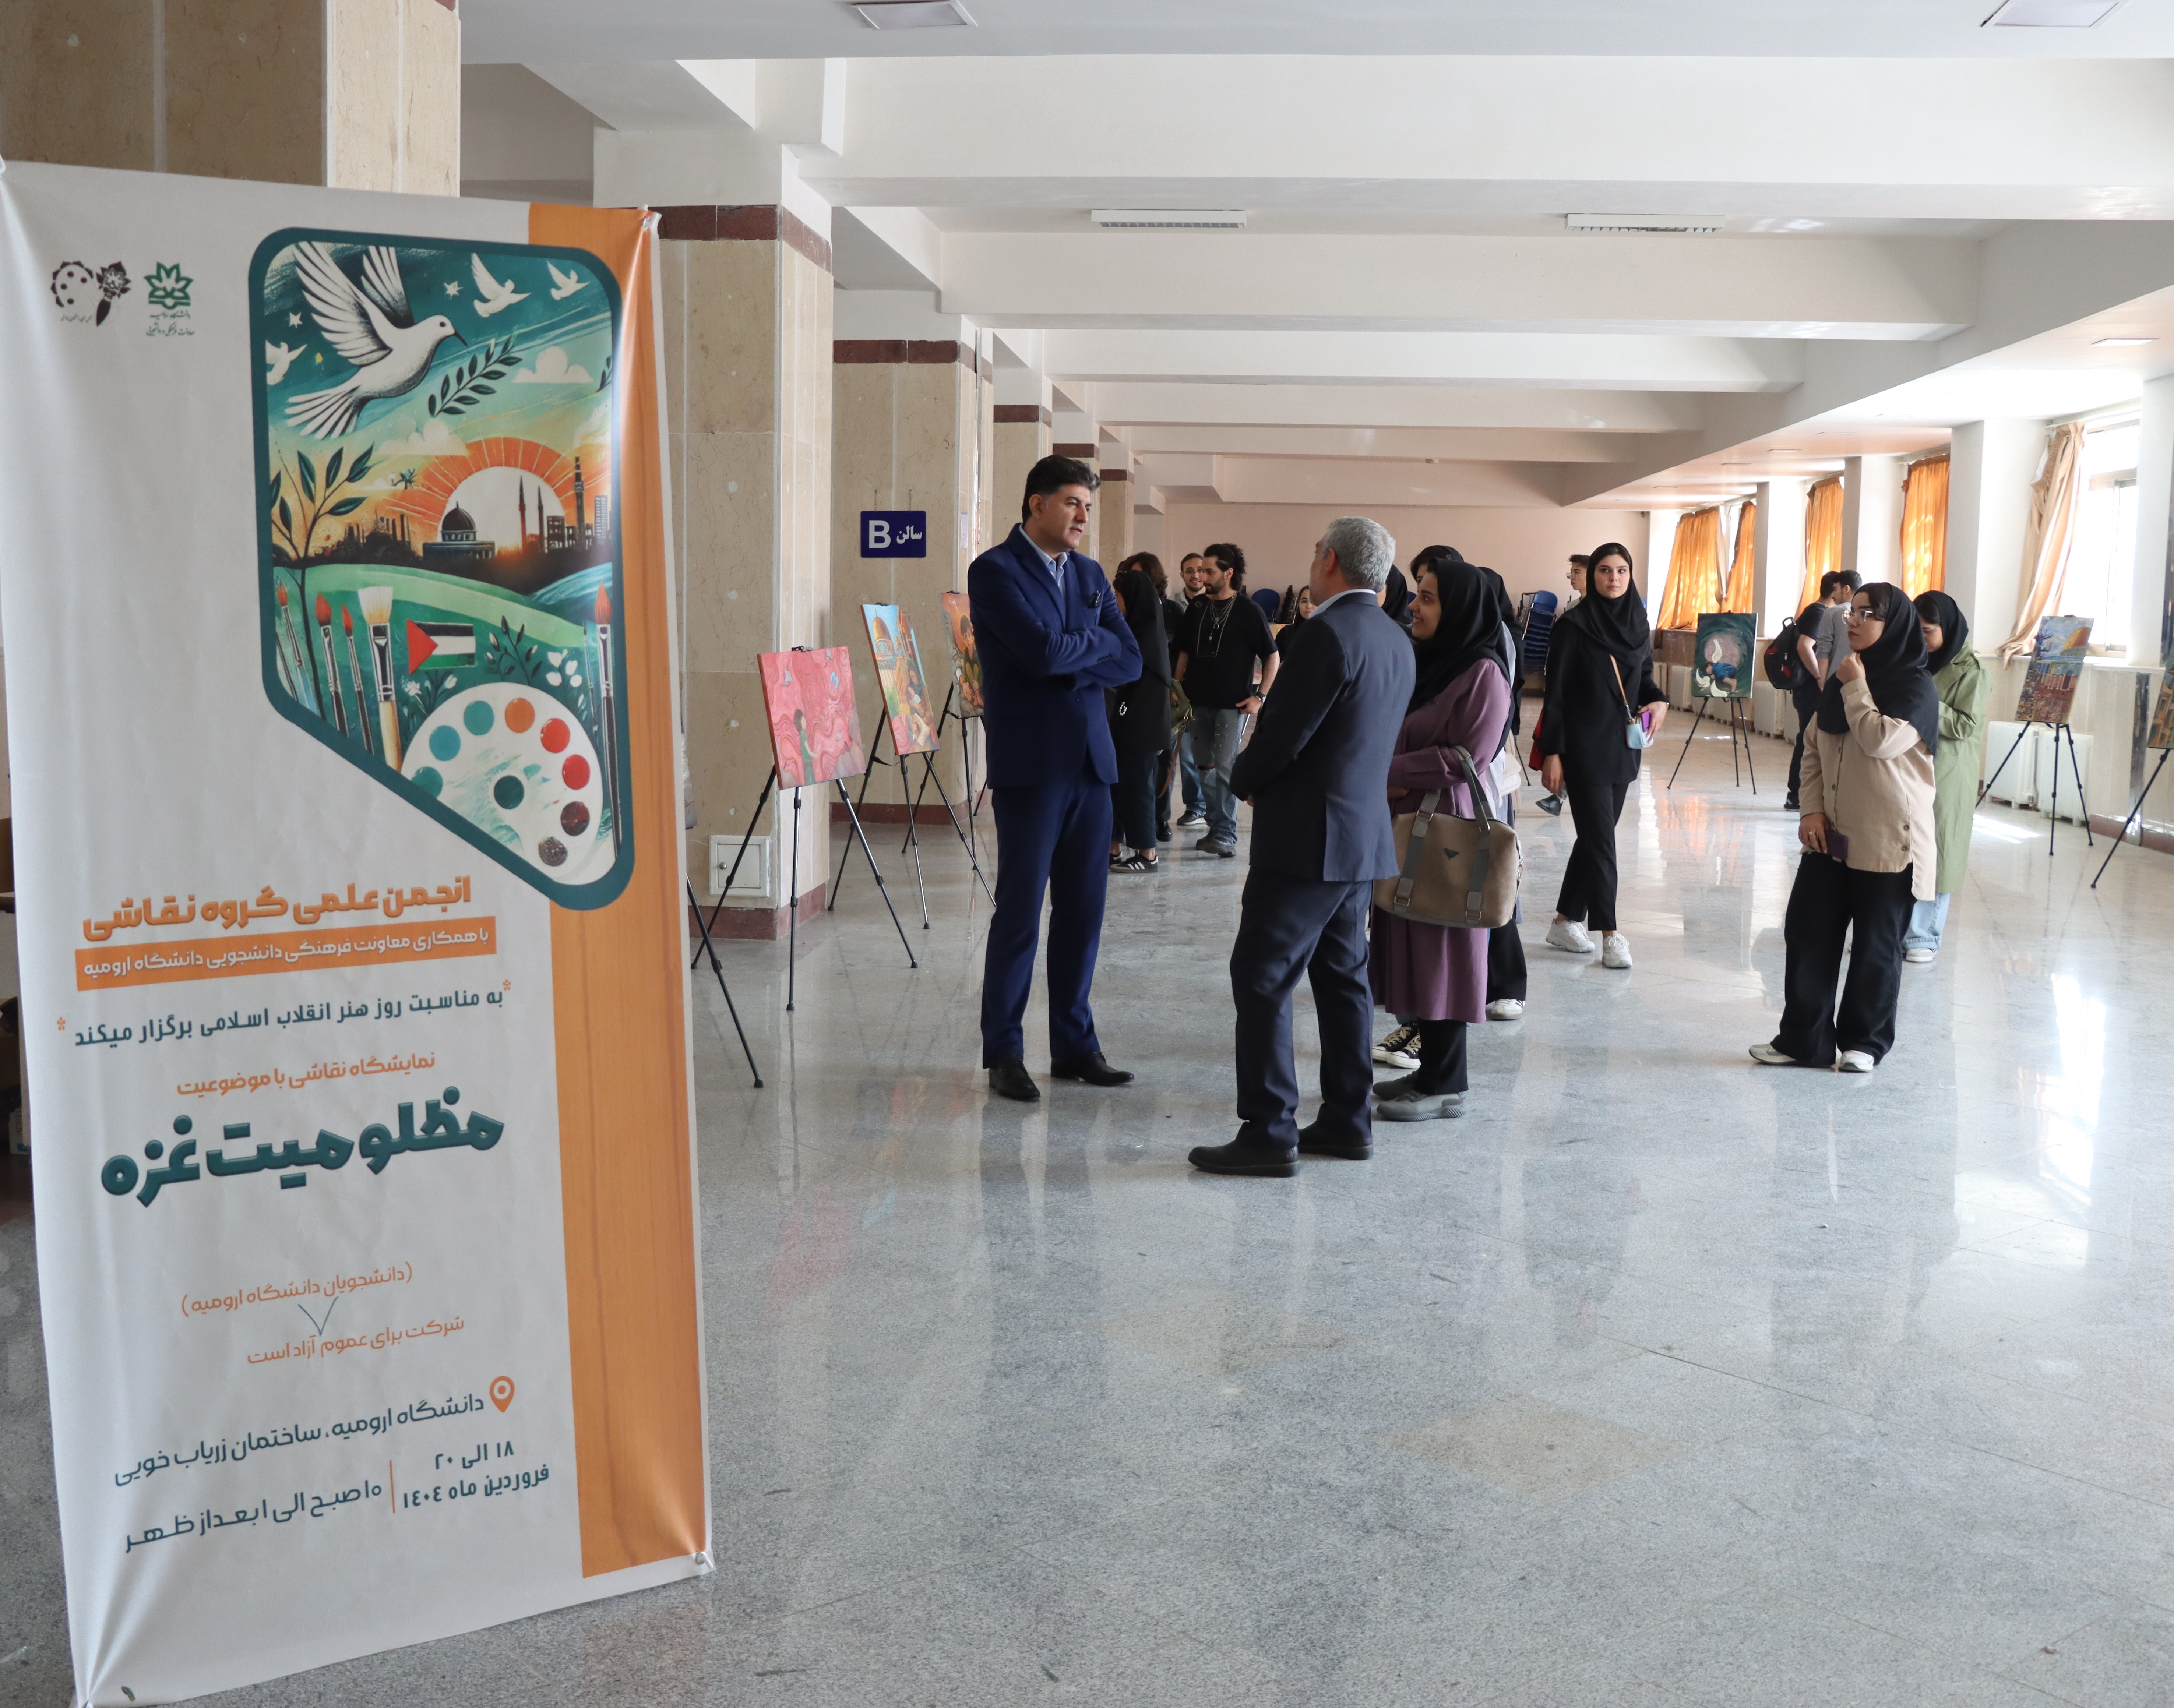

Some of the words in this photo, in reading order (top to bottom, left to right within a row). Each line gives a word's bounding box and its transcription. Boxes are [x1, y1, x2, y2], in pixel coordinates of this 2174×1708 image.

[869, 520, 891, 548] B
[896, 525, 922, 544] سالن
[201, 886, 288, 929] گروه
[293, 883, 378, 925] علمی
[383, 876, 471, 918] انجمن
[83, 894, 196, 942] نقاشی
[354, 935, 410, 953] معاونت
[413, 931, 477, 951] همکاری
[479, 927, 489, 945] با
[135, 951, 203, 969] دانشگاه
[207, 945, 282, 968] دانشجویی
[285, 942, 351, 962] فرهنگی
[84, 957, 130, 978] ارومیه
[374, 998, 401, 1020] روز
[409, 990, 479, 1014] مناسبت
[487, 992, 502, 1007] به
[201, 1008, 269, 1037] اسلامی
[277, 1002, 330, 1028] انقلاب
[337, 1001, 368, 1023] هنر
[75, 1024, 132, 1048] میکند
[139, 1014, 192, 1043] برگزار
[289, 1063, 345, 1088] نقاشی
[350, 1052, 435, 1076] نمایشگاه
[177, 1072, 271, 1098] موضوعیت
[274, 1068, 285, 1089] با
[206, 1086, 504, 1189] مظلومیت
[101, 1115, 200, 1208] غزه
[247, 1280, 320, 1302] دانشگاه
[371, 1329, 401, 1349] برای
[406, 1317, 463, 1337] شرکت
[248, 1344, 289, 1363] است
[295, 1335, 315, 1356] آزاد
[321, 1337, 366, 1355] عموم
[397, 1393, 484, 1424] دانشگاه
[174, 1439, 226, 1468] زریاب
[231, 1424, 321, 1461] ساختمان
[462, 1443, 488, 1469] الی
[115, 1451, 170, 1486] خویی
[484, 1464, 549, 1496] فروردین
[448, 1480, 476, 1499] ماه
[273, 1492, 305, 1523] الی
[311, 1489, 361, 1517] صبح
[126, 1515, 195, 1553] ظهر
